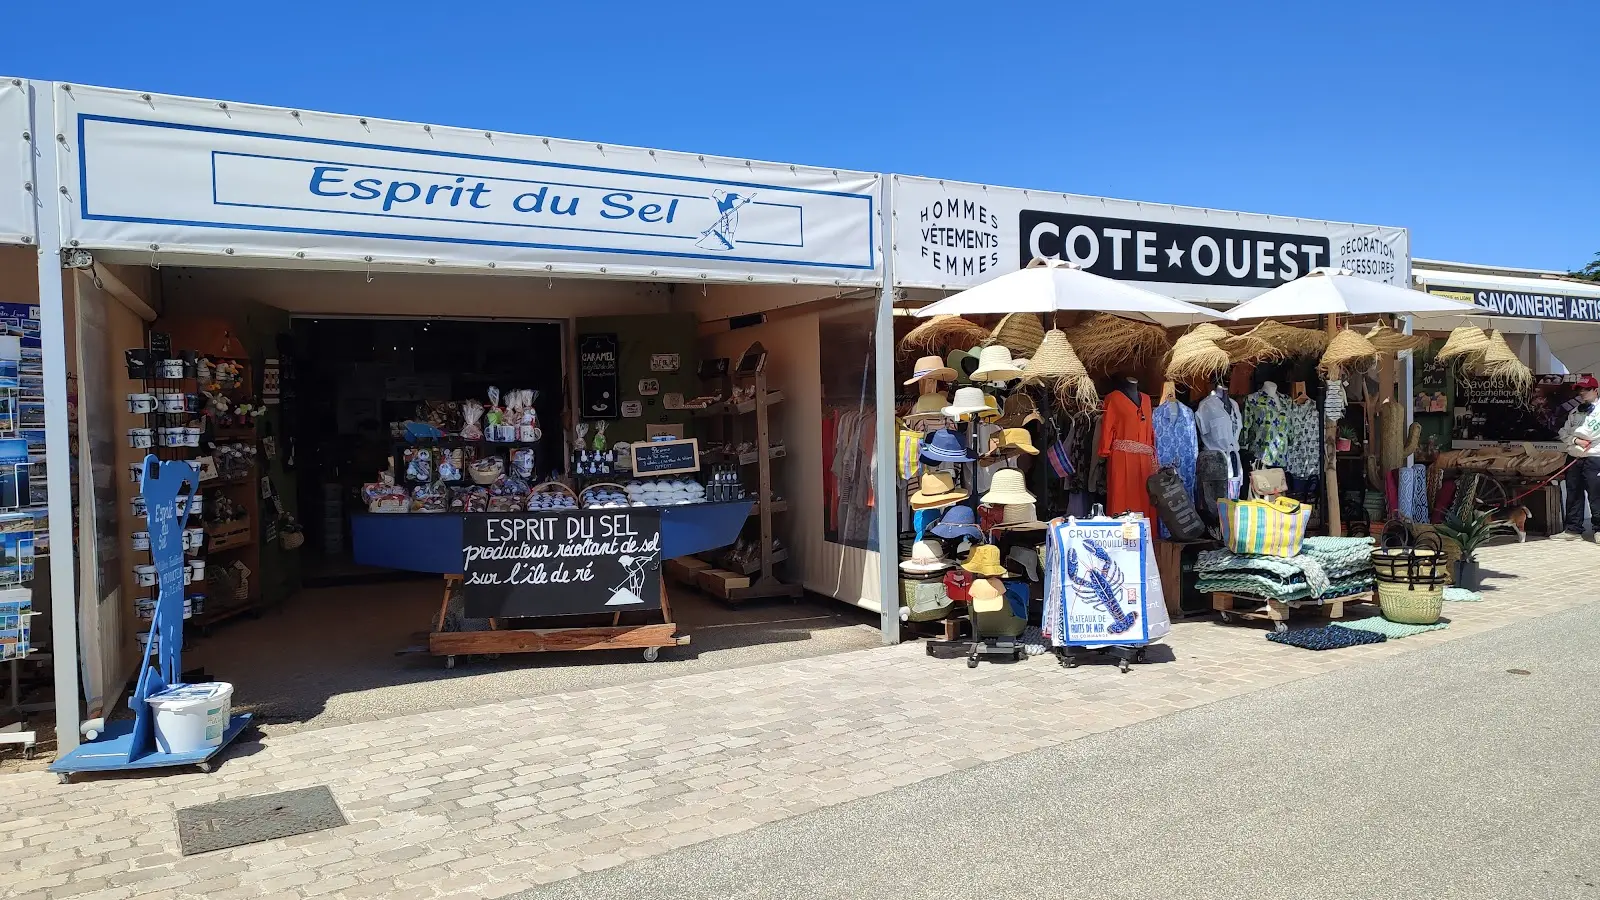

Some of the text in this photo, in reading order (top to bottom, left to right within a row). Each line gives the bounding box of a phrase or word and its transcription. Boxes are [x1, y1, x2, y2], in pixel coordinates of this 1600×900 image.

[308, 166, 679, 224] Esprit du Sel
[920, 198, 998, 229] HOMMES
[921, 223, 998, 249] VÊTEMENTS
[1340, 236, 1395, 260] DÉCORATION
[921, 247, 998, 276] FEMMES
[1029, 221, 1324, 281] COTE OUEST
[1341, 256, 1395, 275] ACCESSOIRES
[1477, 291, 1565, 318] SAVONNERIE
[581, 351, 616, 362] CARAMEL
[487, 514, 638, 542] ESPRIT DU SEL
[1068, 529, 1121, 539] CRUSTAC
[462, 532, 661, 571] producteur récoltant de sel
[465, 568, 502, 585] sur
[549, 562, 570, 583] de
[571, 561, 595, 582] ré
